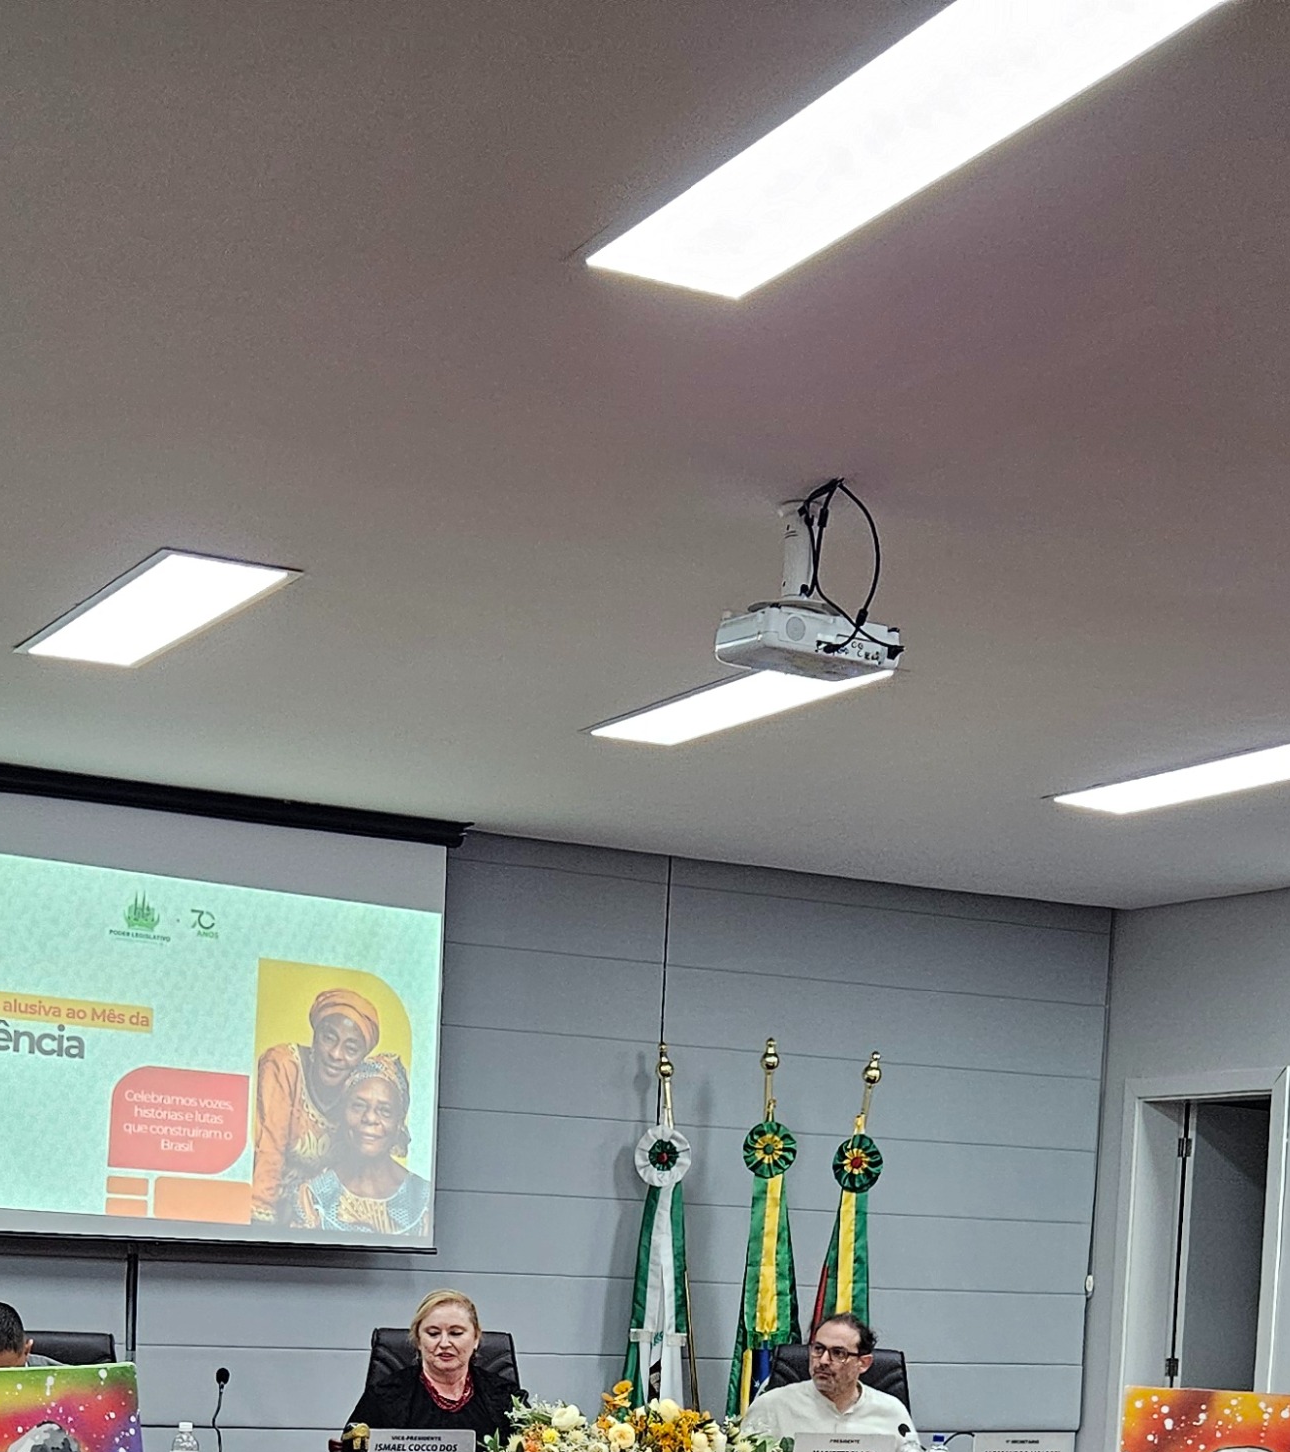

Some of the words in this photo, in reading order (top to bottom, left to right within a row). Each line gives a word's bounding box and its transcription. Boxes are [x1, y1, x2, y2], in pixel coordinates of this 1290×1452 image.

[197, 930, 219, 939] ANOS
[2, 999, 61, 1018] alusiva
[65, 1007, 87, 1020] ao
[91, 1007, 125, 1024] Mês
[129, 1011, 150, 1027] da
[124, 1089, 197, 1107] Celebramos
[199, 1098, 234, 1111] vozes,
[134, 1105, 183, 1121] histórias
[185, 1113, 194, 1122] e
[195, 1110, 224, 1124] lutas
[123, 1122, 148, 1135] que
[224, 1131, 233, 1140] o
[374, 1443, 406, 1452] ISMAEL
[408, 1443, 438, 1452] COCCO
[439, 1443, 458, 1452] DOS
